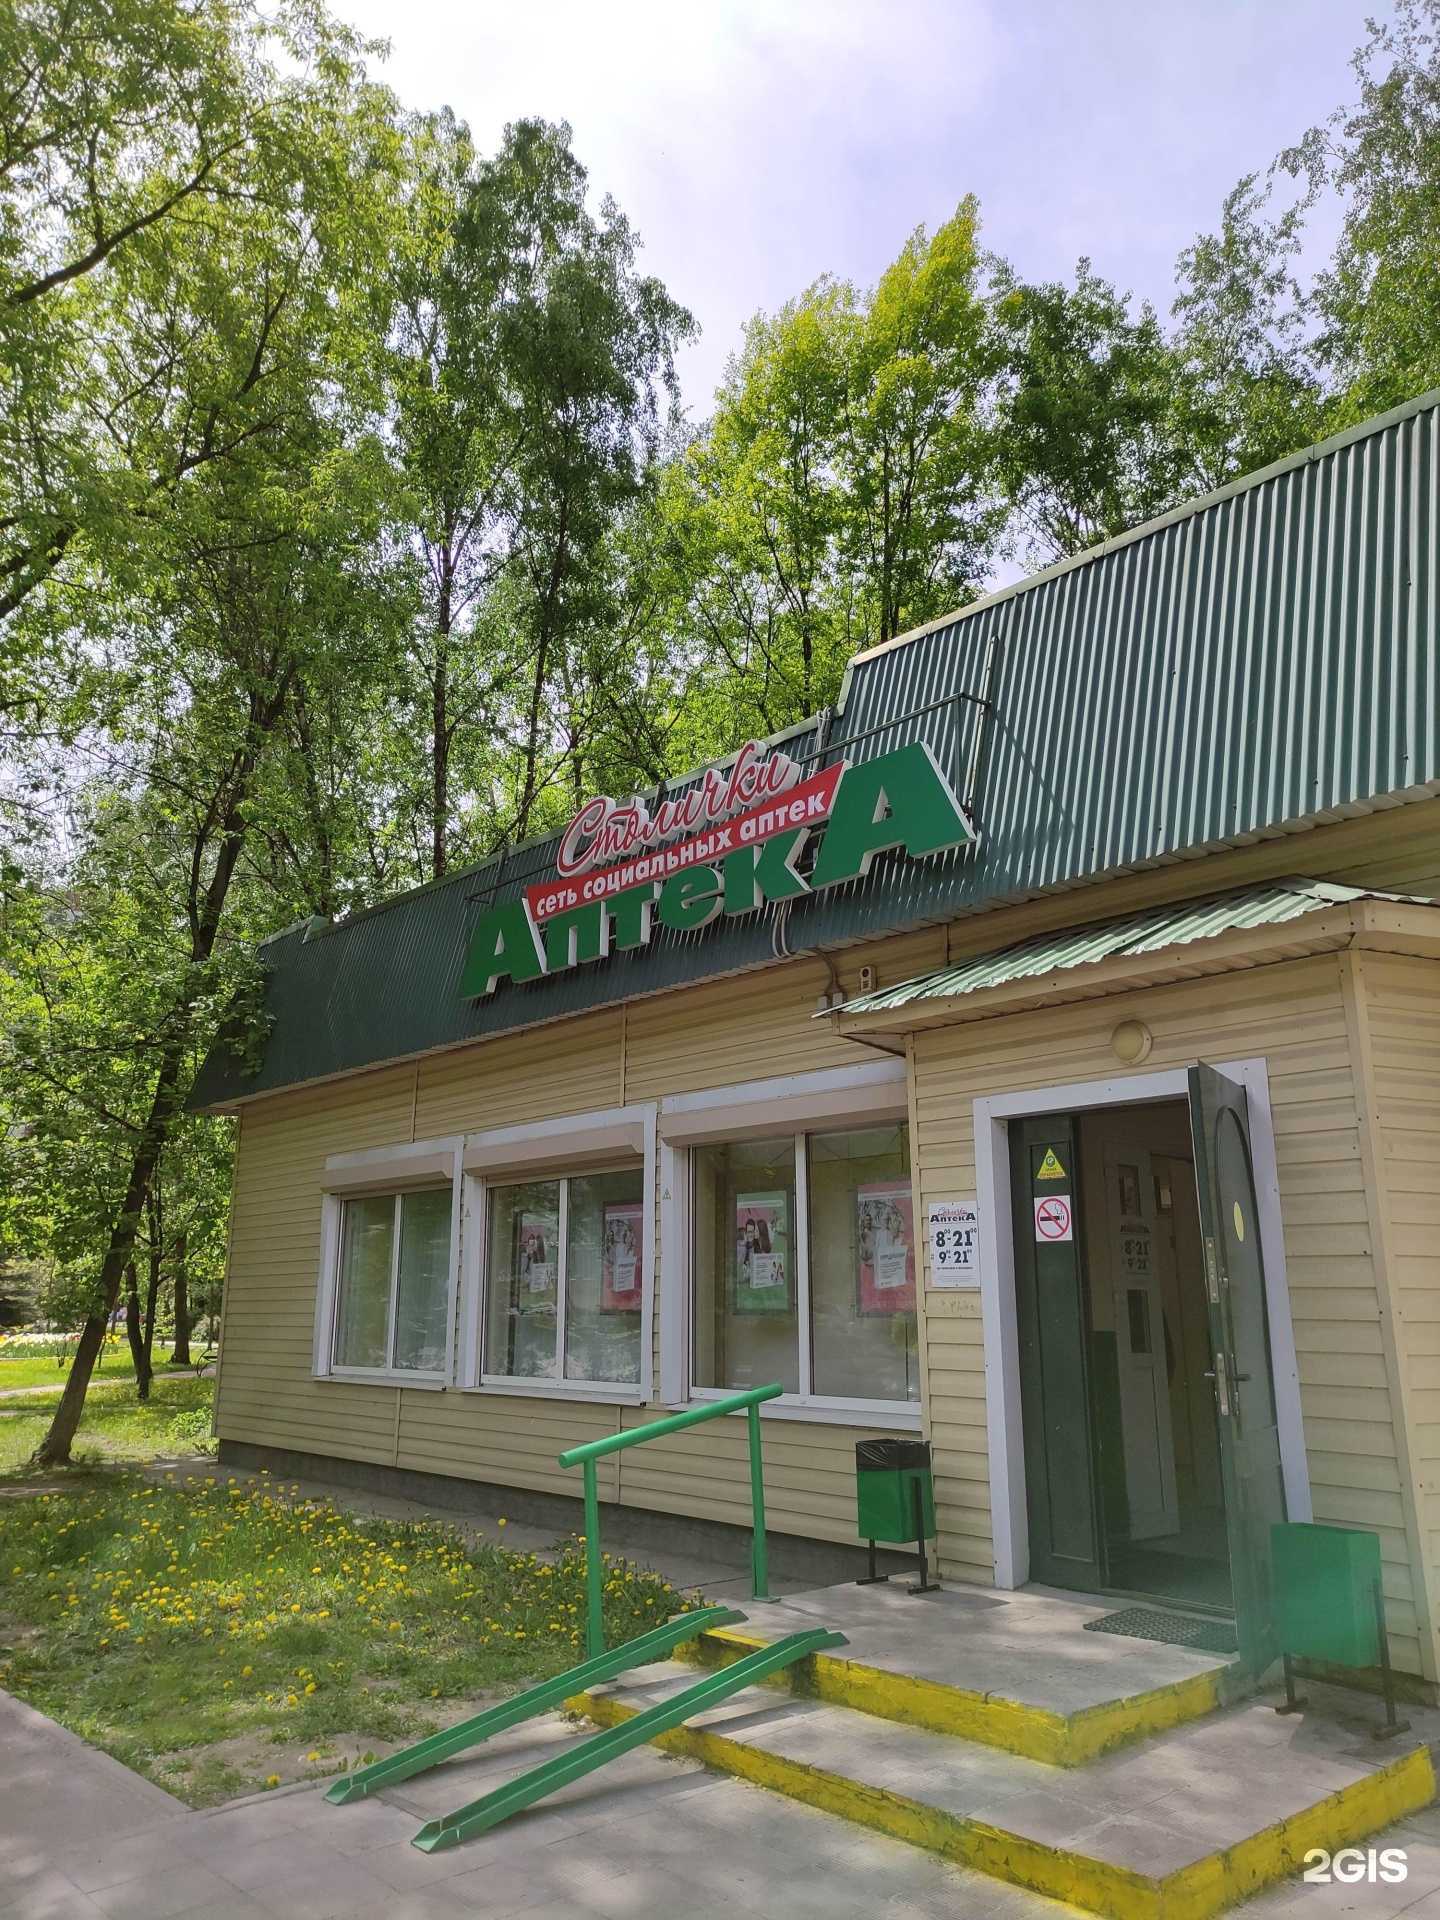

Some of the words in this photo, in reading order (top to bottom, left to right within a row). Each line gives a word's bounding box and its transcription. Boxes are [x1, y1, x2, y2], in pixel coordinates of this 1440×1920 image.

[536, 886, 577, 916] сеть
[583, 828, 733, 899] социальных
[740, 790, 826, 841] аптек
[557, 741, 800, 877] Столички
